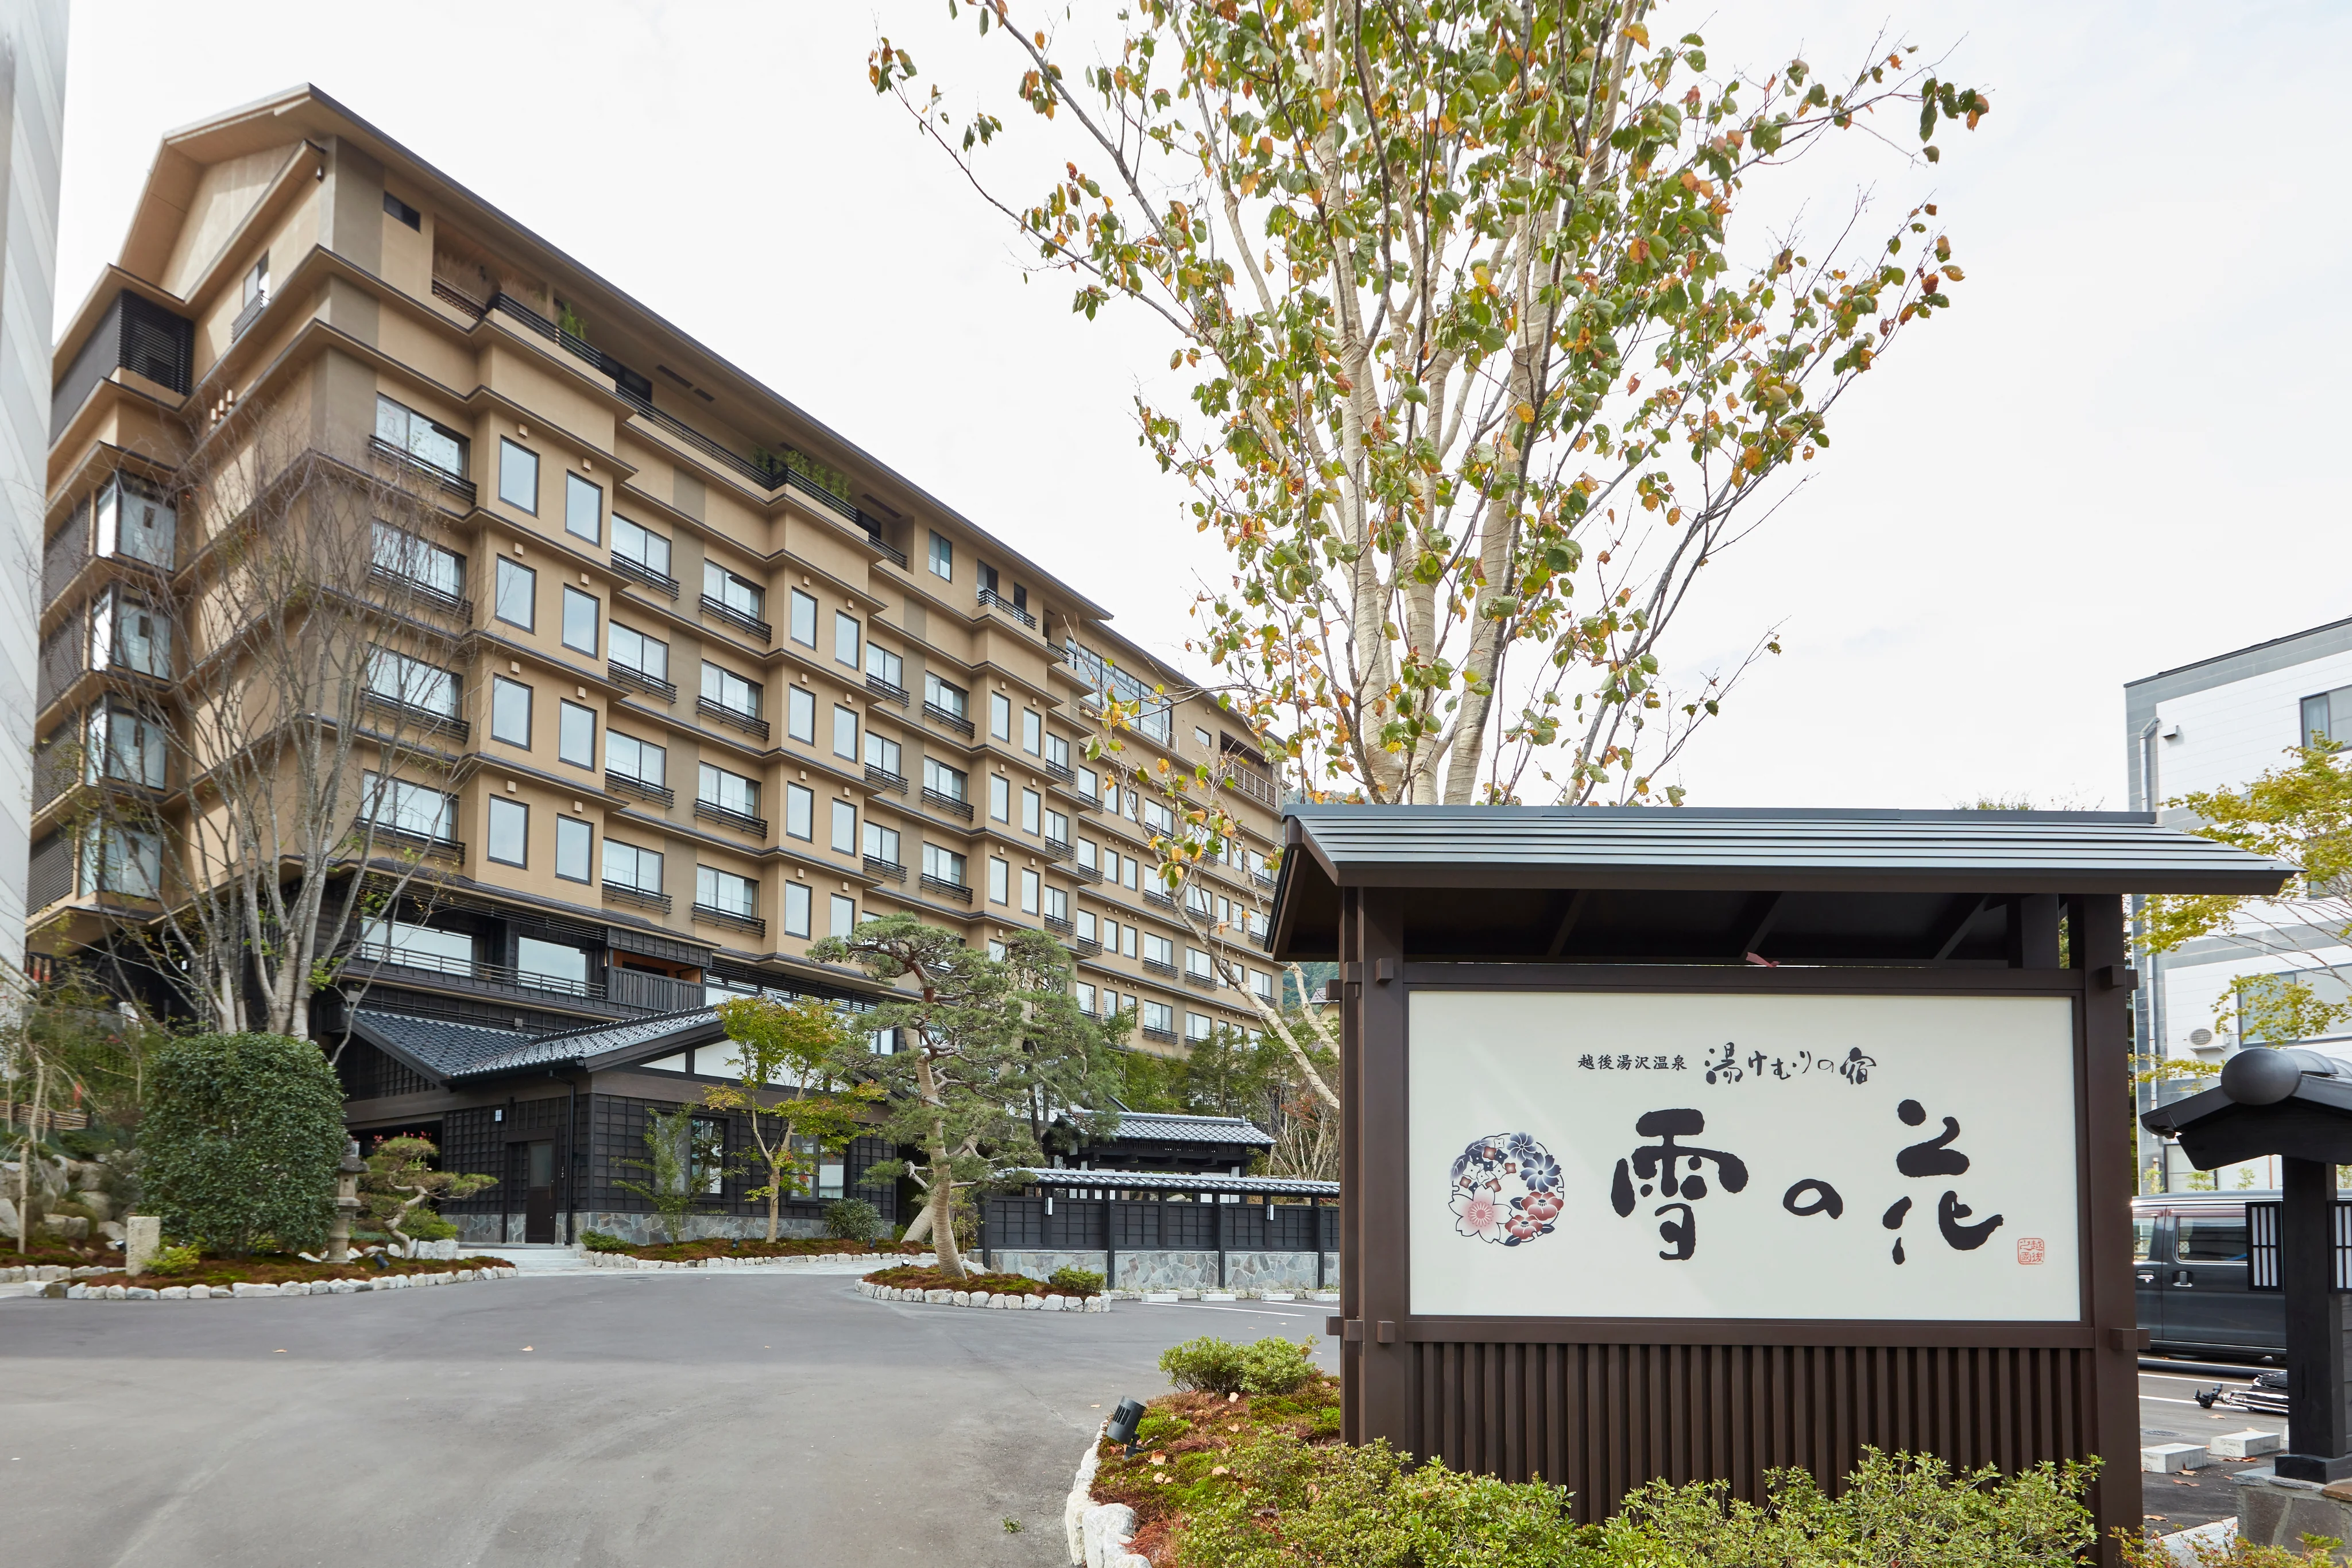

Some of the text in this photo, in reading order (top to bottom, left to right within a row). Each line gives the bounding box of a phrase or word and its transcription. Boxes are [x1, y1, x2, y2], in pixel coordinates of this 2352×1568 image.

[1577, 1042, 1877, 1085] 越後湯沢温泉 湯けむりの宿
[1611, 1099, 2004, 1265] 雪の花
